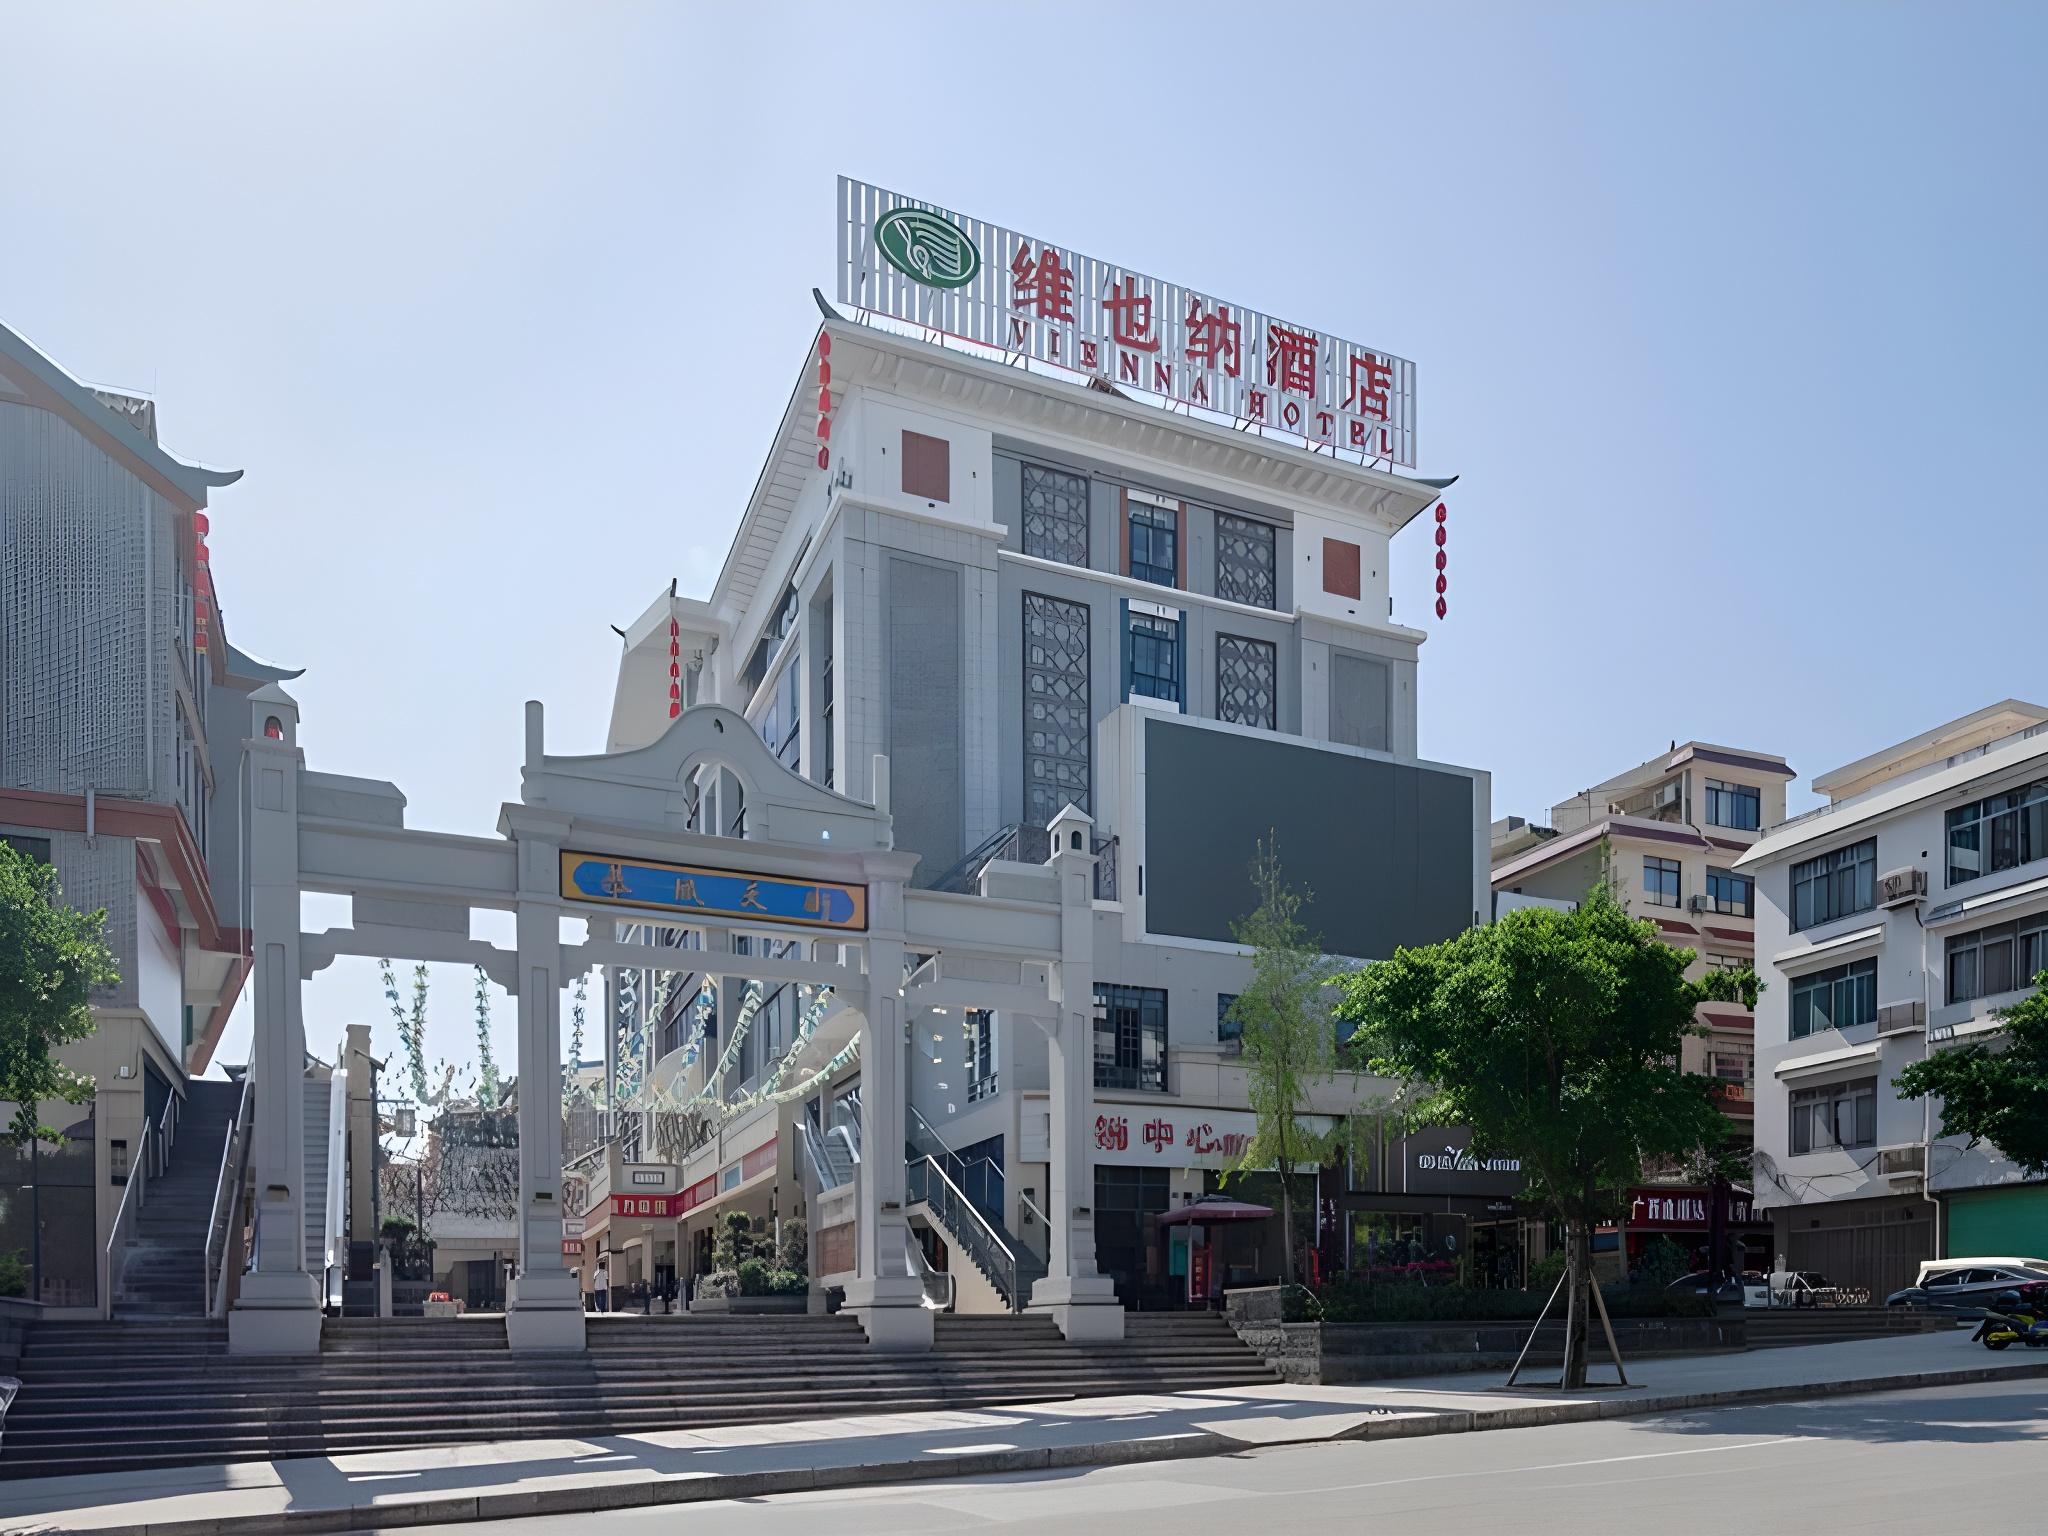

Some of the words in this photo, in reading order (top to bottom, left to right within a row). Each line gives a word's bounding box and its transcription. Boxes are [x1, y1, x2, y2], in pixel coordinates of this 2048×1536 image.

[1010, 316, 1209, 408] VIENNA
[1249, 390, 1393, 454] HOTEL
[1011, 240, 1393, 422] 维也纳酒店
